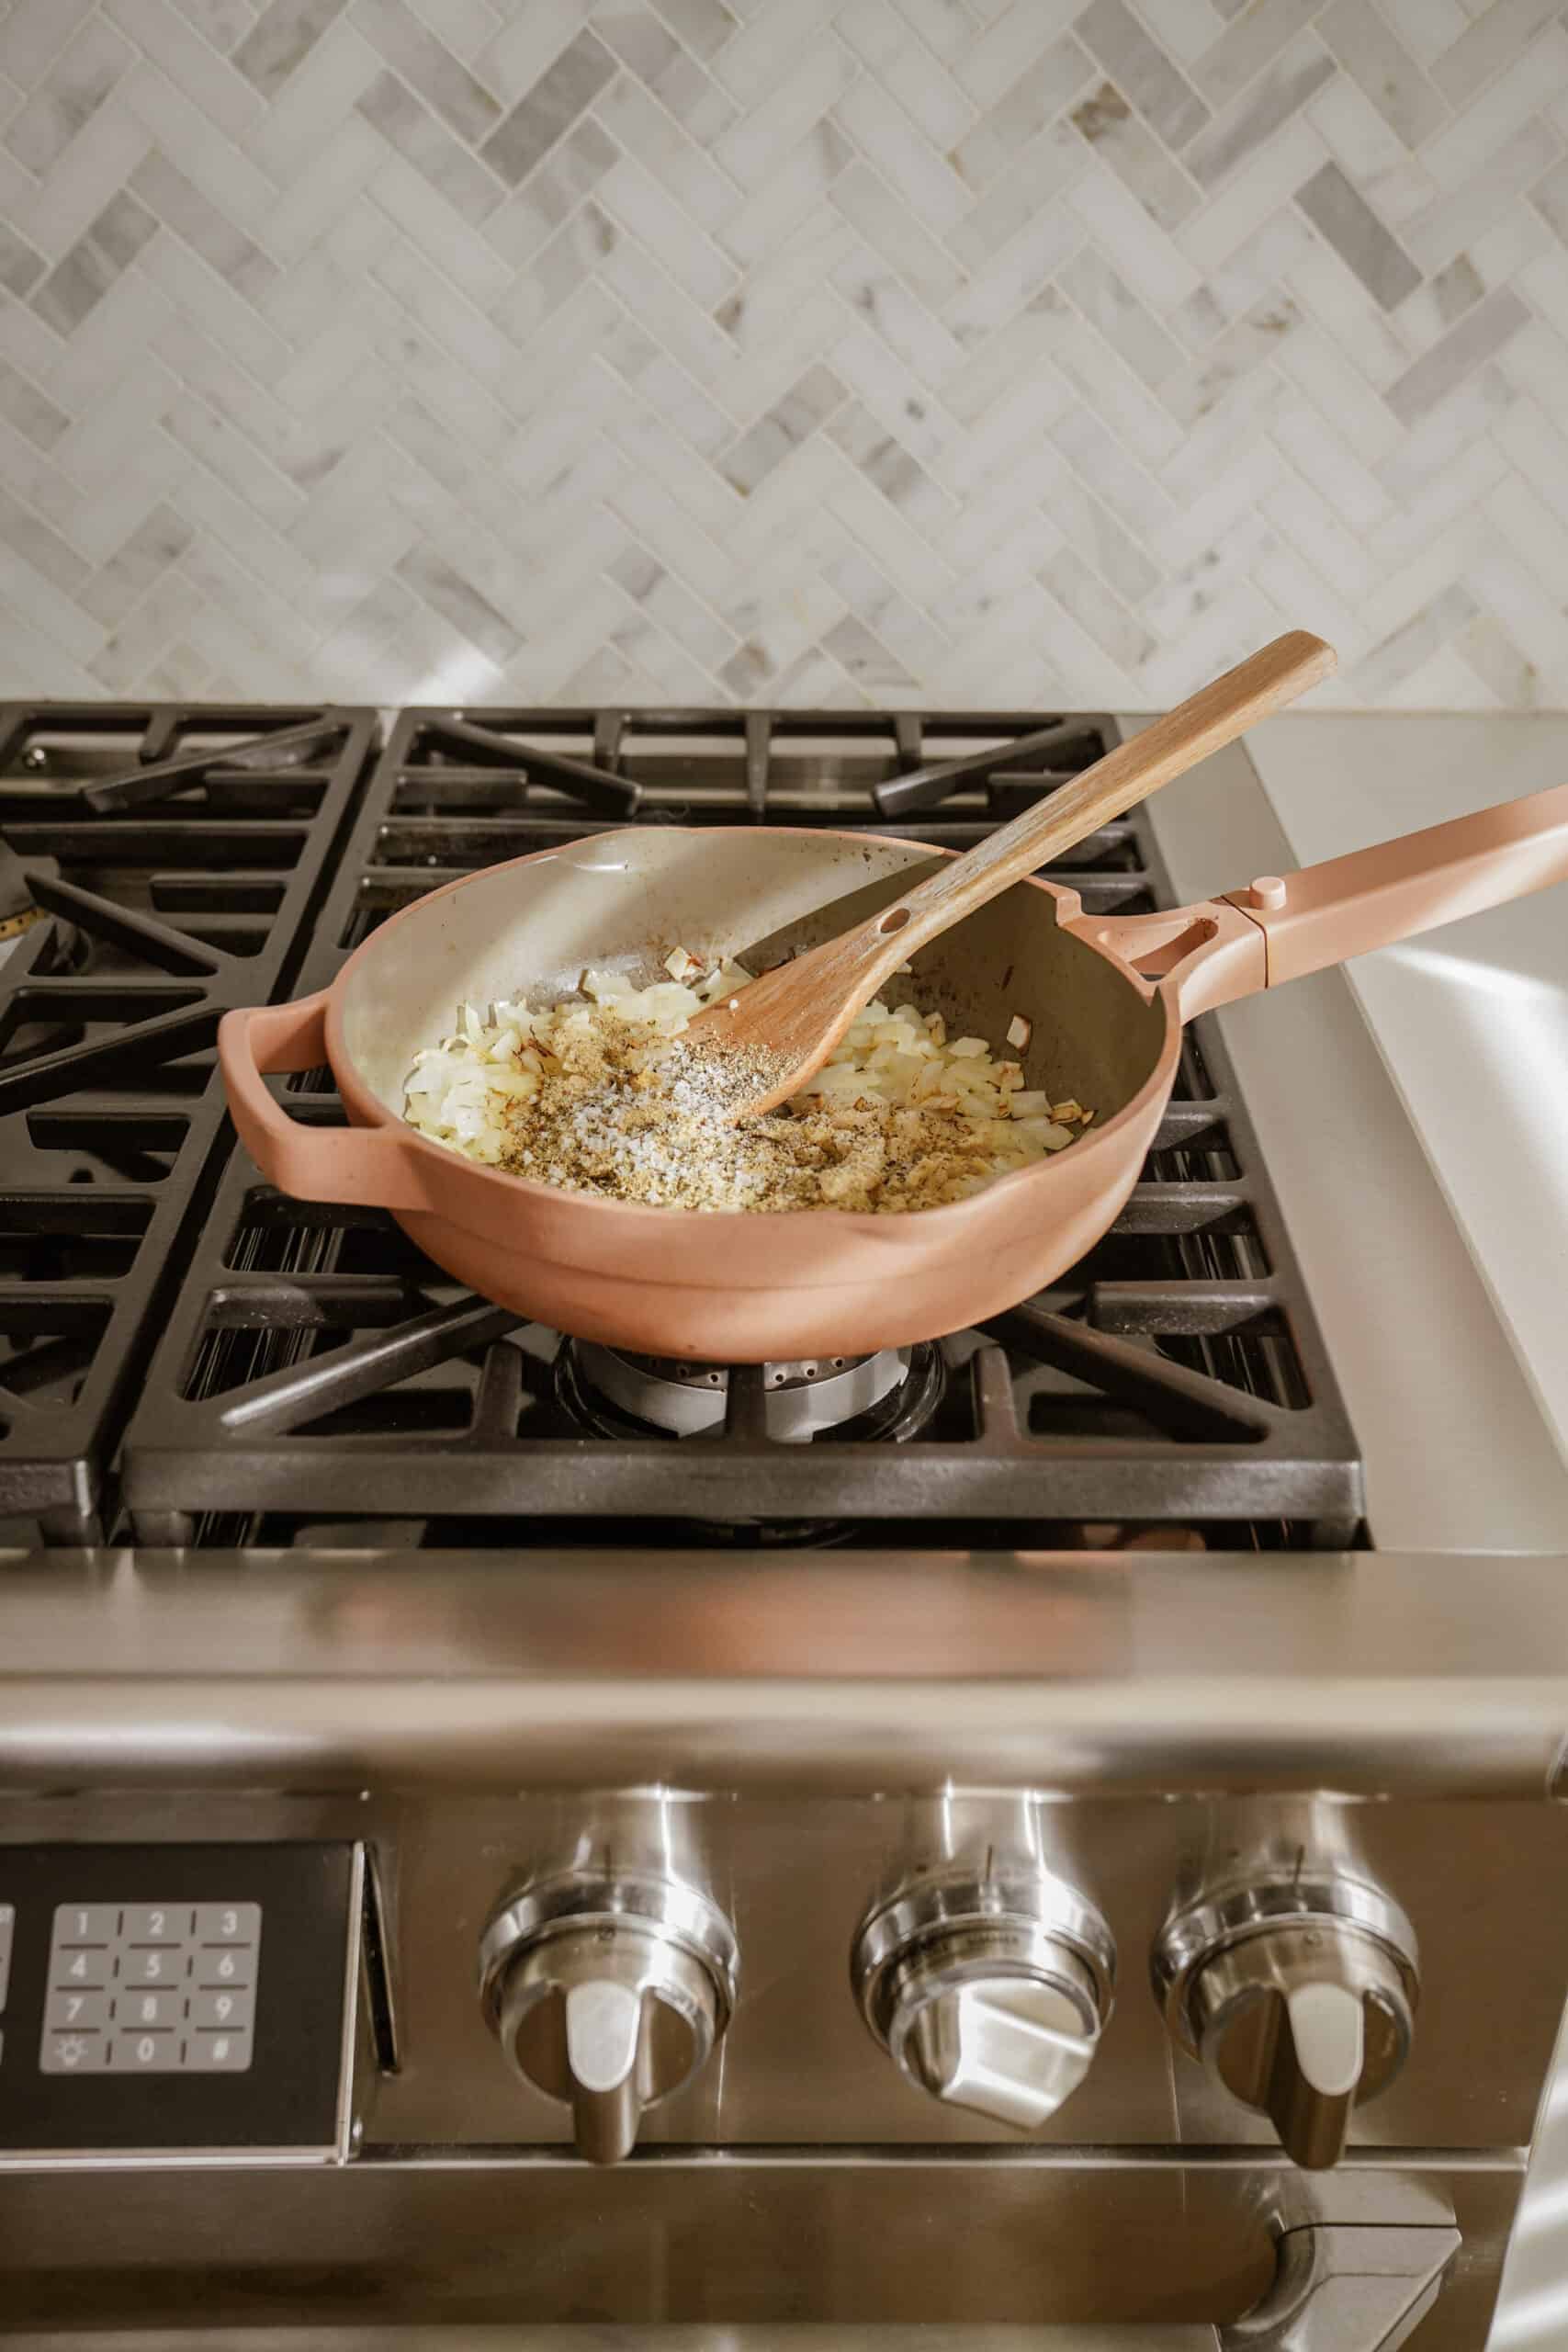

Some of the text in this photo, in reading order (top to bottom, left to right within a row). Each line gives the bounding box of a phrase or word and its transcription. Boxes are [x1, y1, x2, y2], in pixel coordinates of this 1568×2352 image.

[77, 1911, 238, 1935] 1 2 3
[70, 1954, 234, 1977] 4 5 6
[67, 1996, 233, 2021] 7 8 9
[137, 2038, 154, 2062] 0
